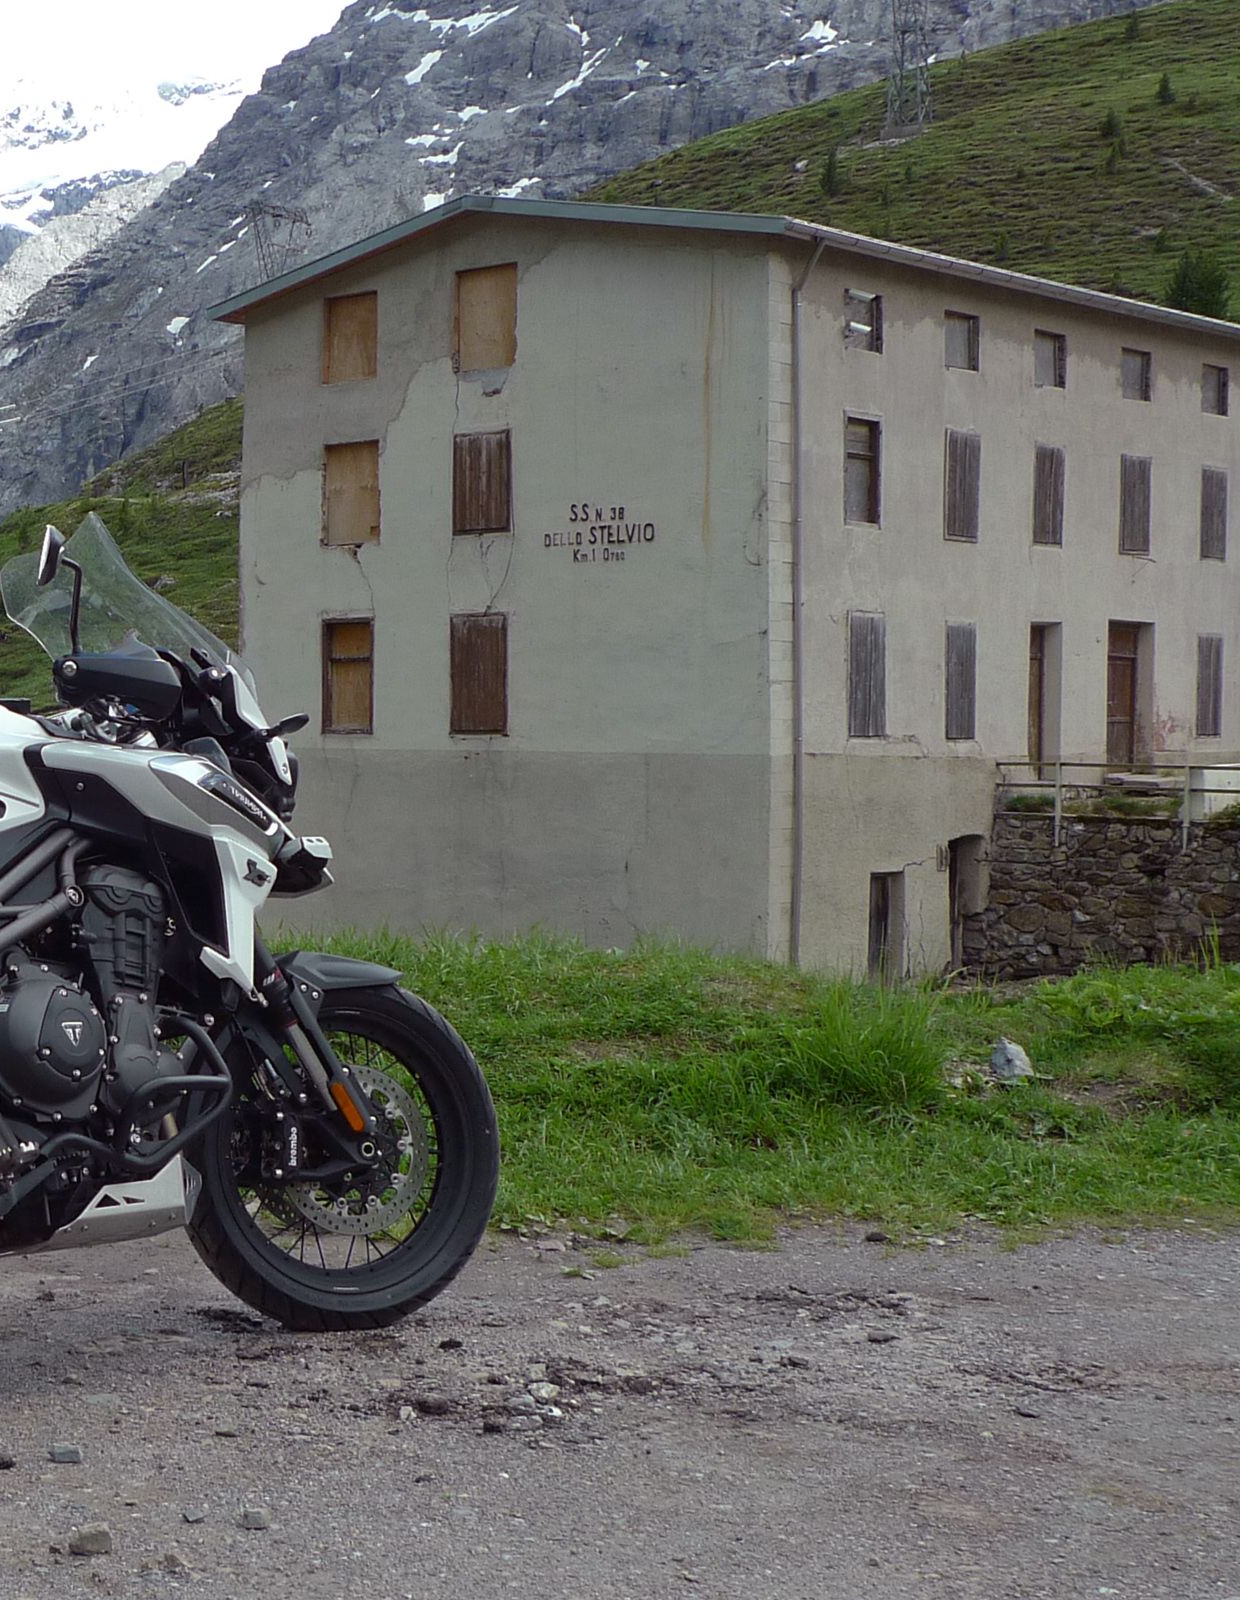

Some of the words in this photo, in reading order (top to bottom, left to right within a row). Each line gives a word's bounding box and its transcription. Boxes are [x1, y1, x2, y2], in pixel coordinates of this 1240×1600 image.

[610, 506, 625, 520] 38
[588, 522, 655, 545] STELVIO
[288, 1126, 298, 1167] brembo
